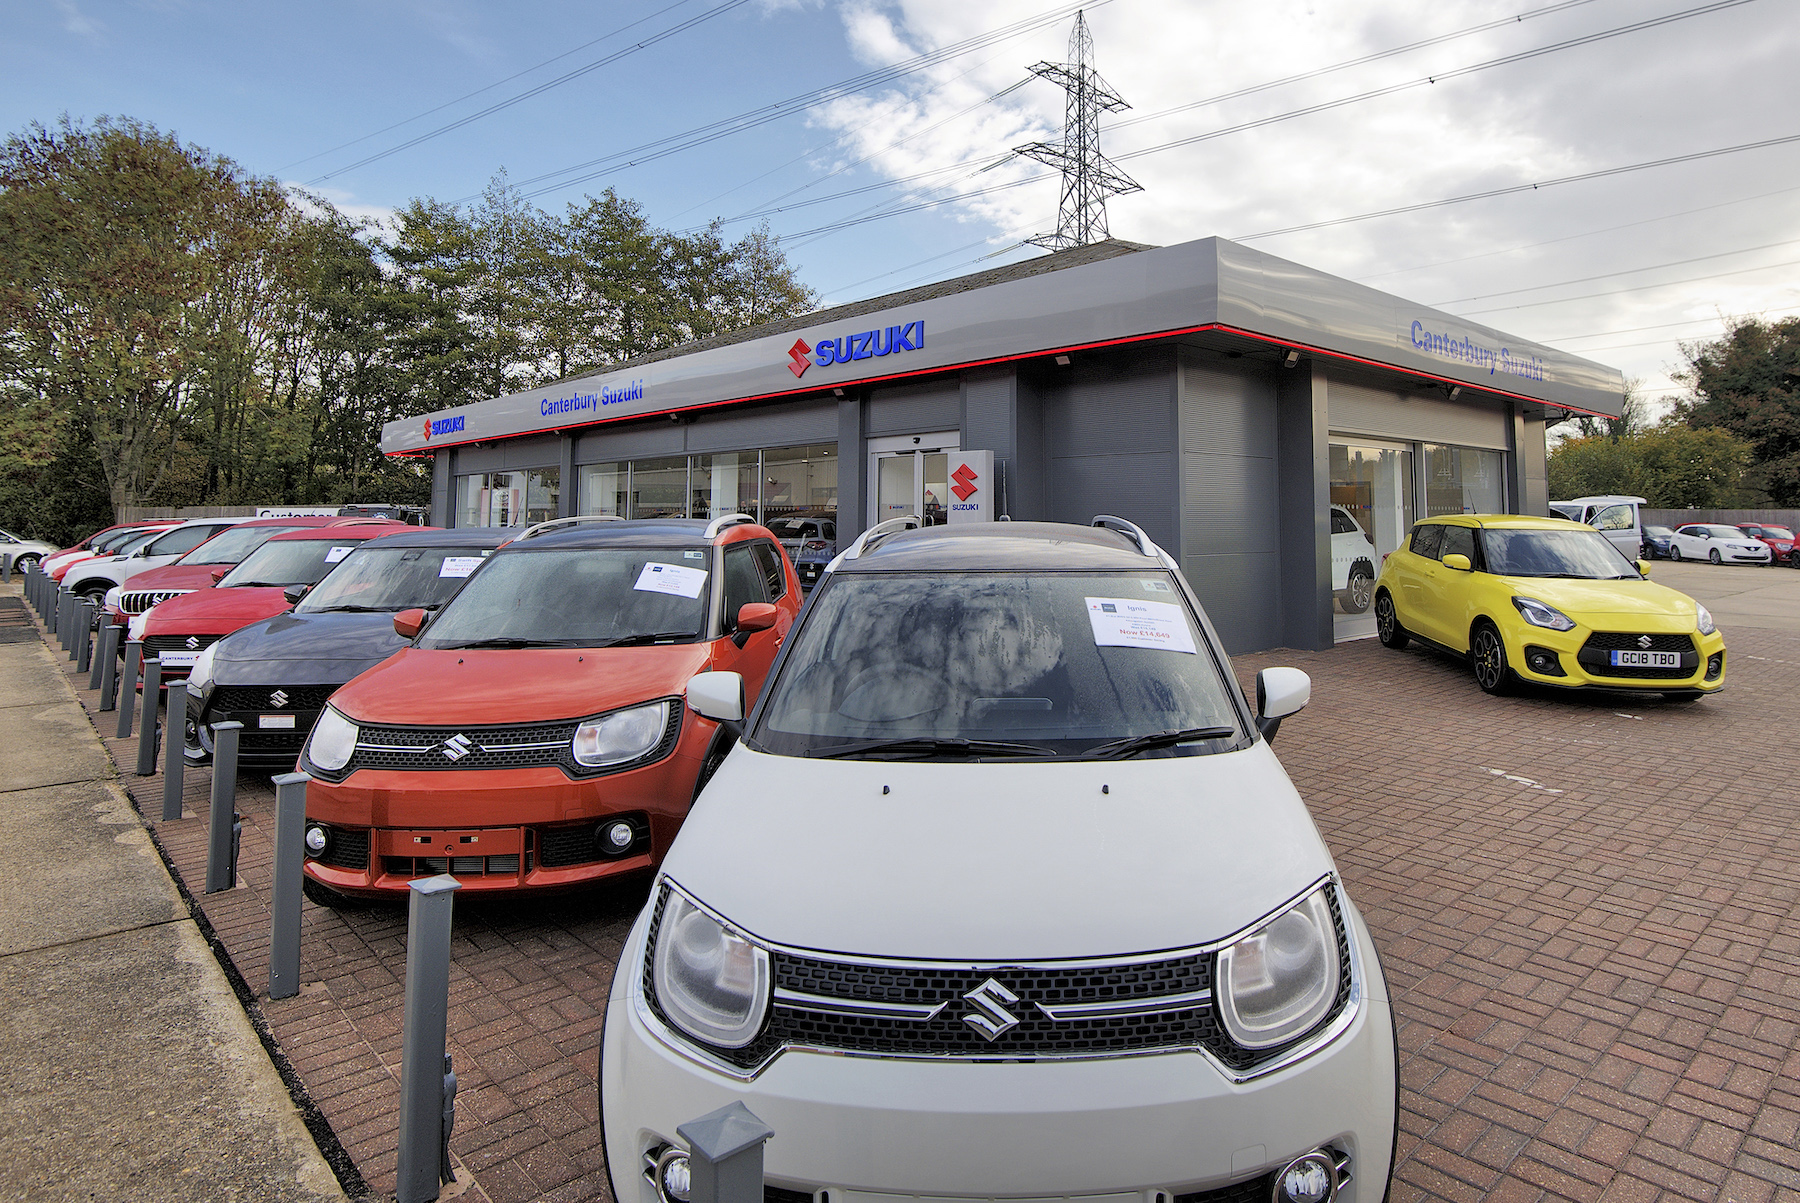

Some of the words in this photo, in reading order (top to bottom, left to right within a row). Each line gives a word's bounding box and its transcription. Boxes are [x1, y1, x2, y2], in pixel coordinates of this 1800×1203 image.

[815, 320, 924, 367] SUZUKI
[1411, 320, 1498, 375] Canterbury
[1501, 347, 1543, 382] Suzuki
[540, 392, 598, 417] Canterbury
[601, 379, 643, 406] Suzuki
[432, 415, 465, 436] SUZUKI
[952, 503, 979, 511] SUZUKI
[1622, 652, 1649, 664] GC18
[1652, 653, 1675, 665] TBO
